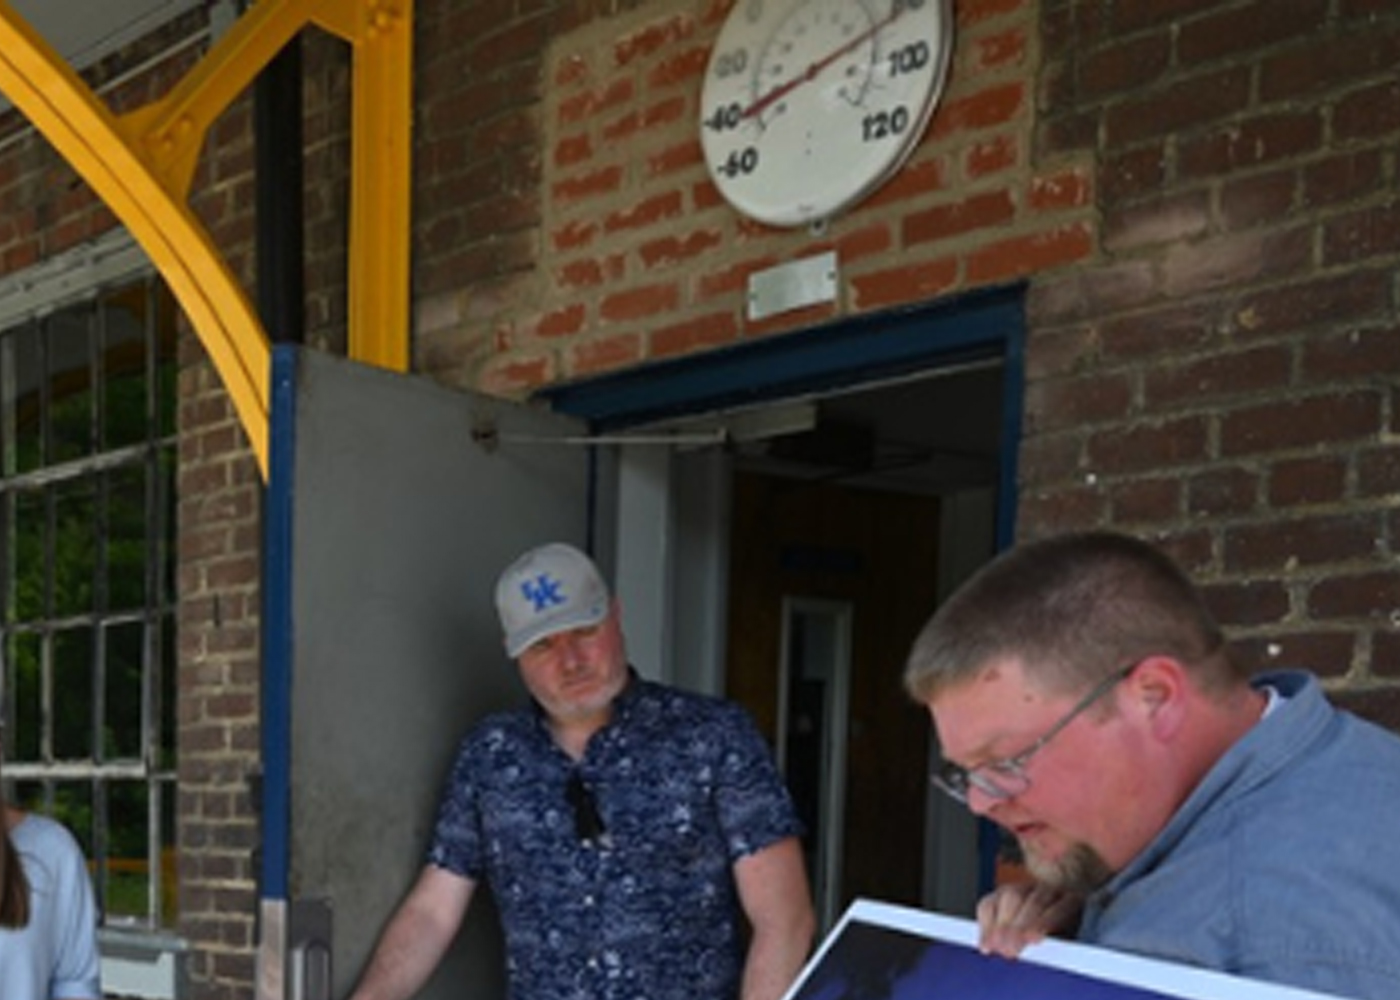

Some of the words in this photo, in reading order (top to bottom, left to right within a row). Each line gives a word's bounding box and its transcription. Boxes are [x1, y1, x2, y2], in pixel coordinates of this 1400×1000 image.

[887, 40, 929, 77] 100
[703, 103, 742, 132] -40
[862, 106, 909, 142] 120
[718, 145, 758, 178] -60
[520, 574, 567, 612] UK
